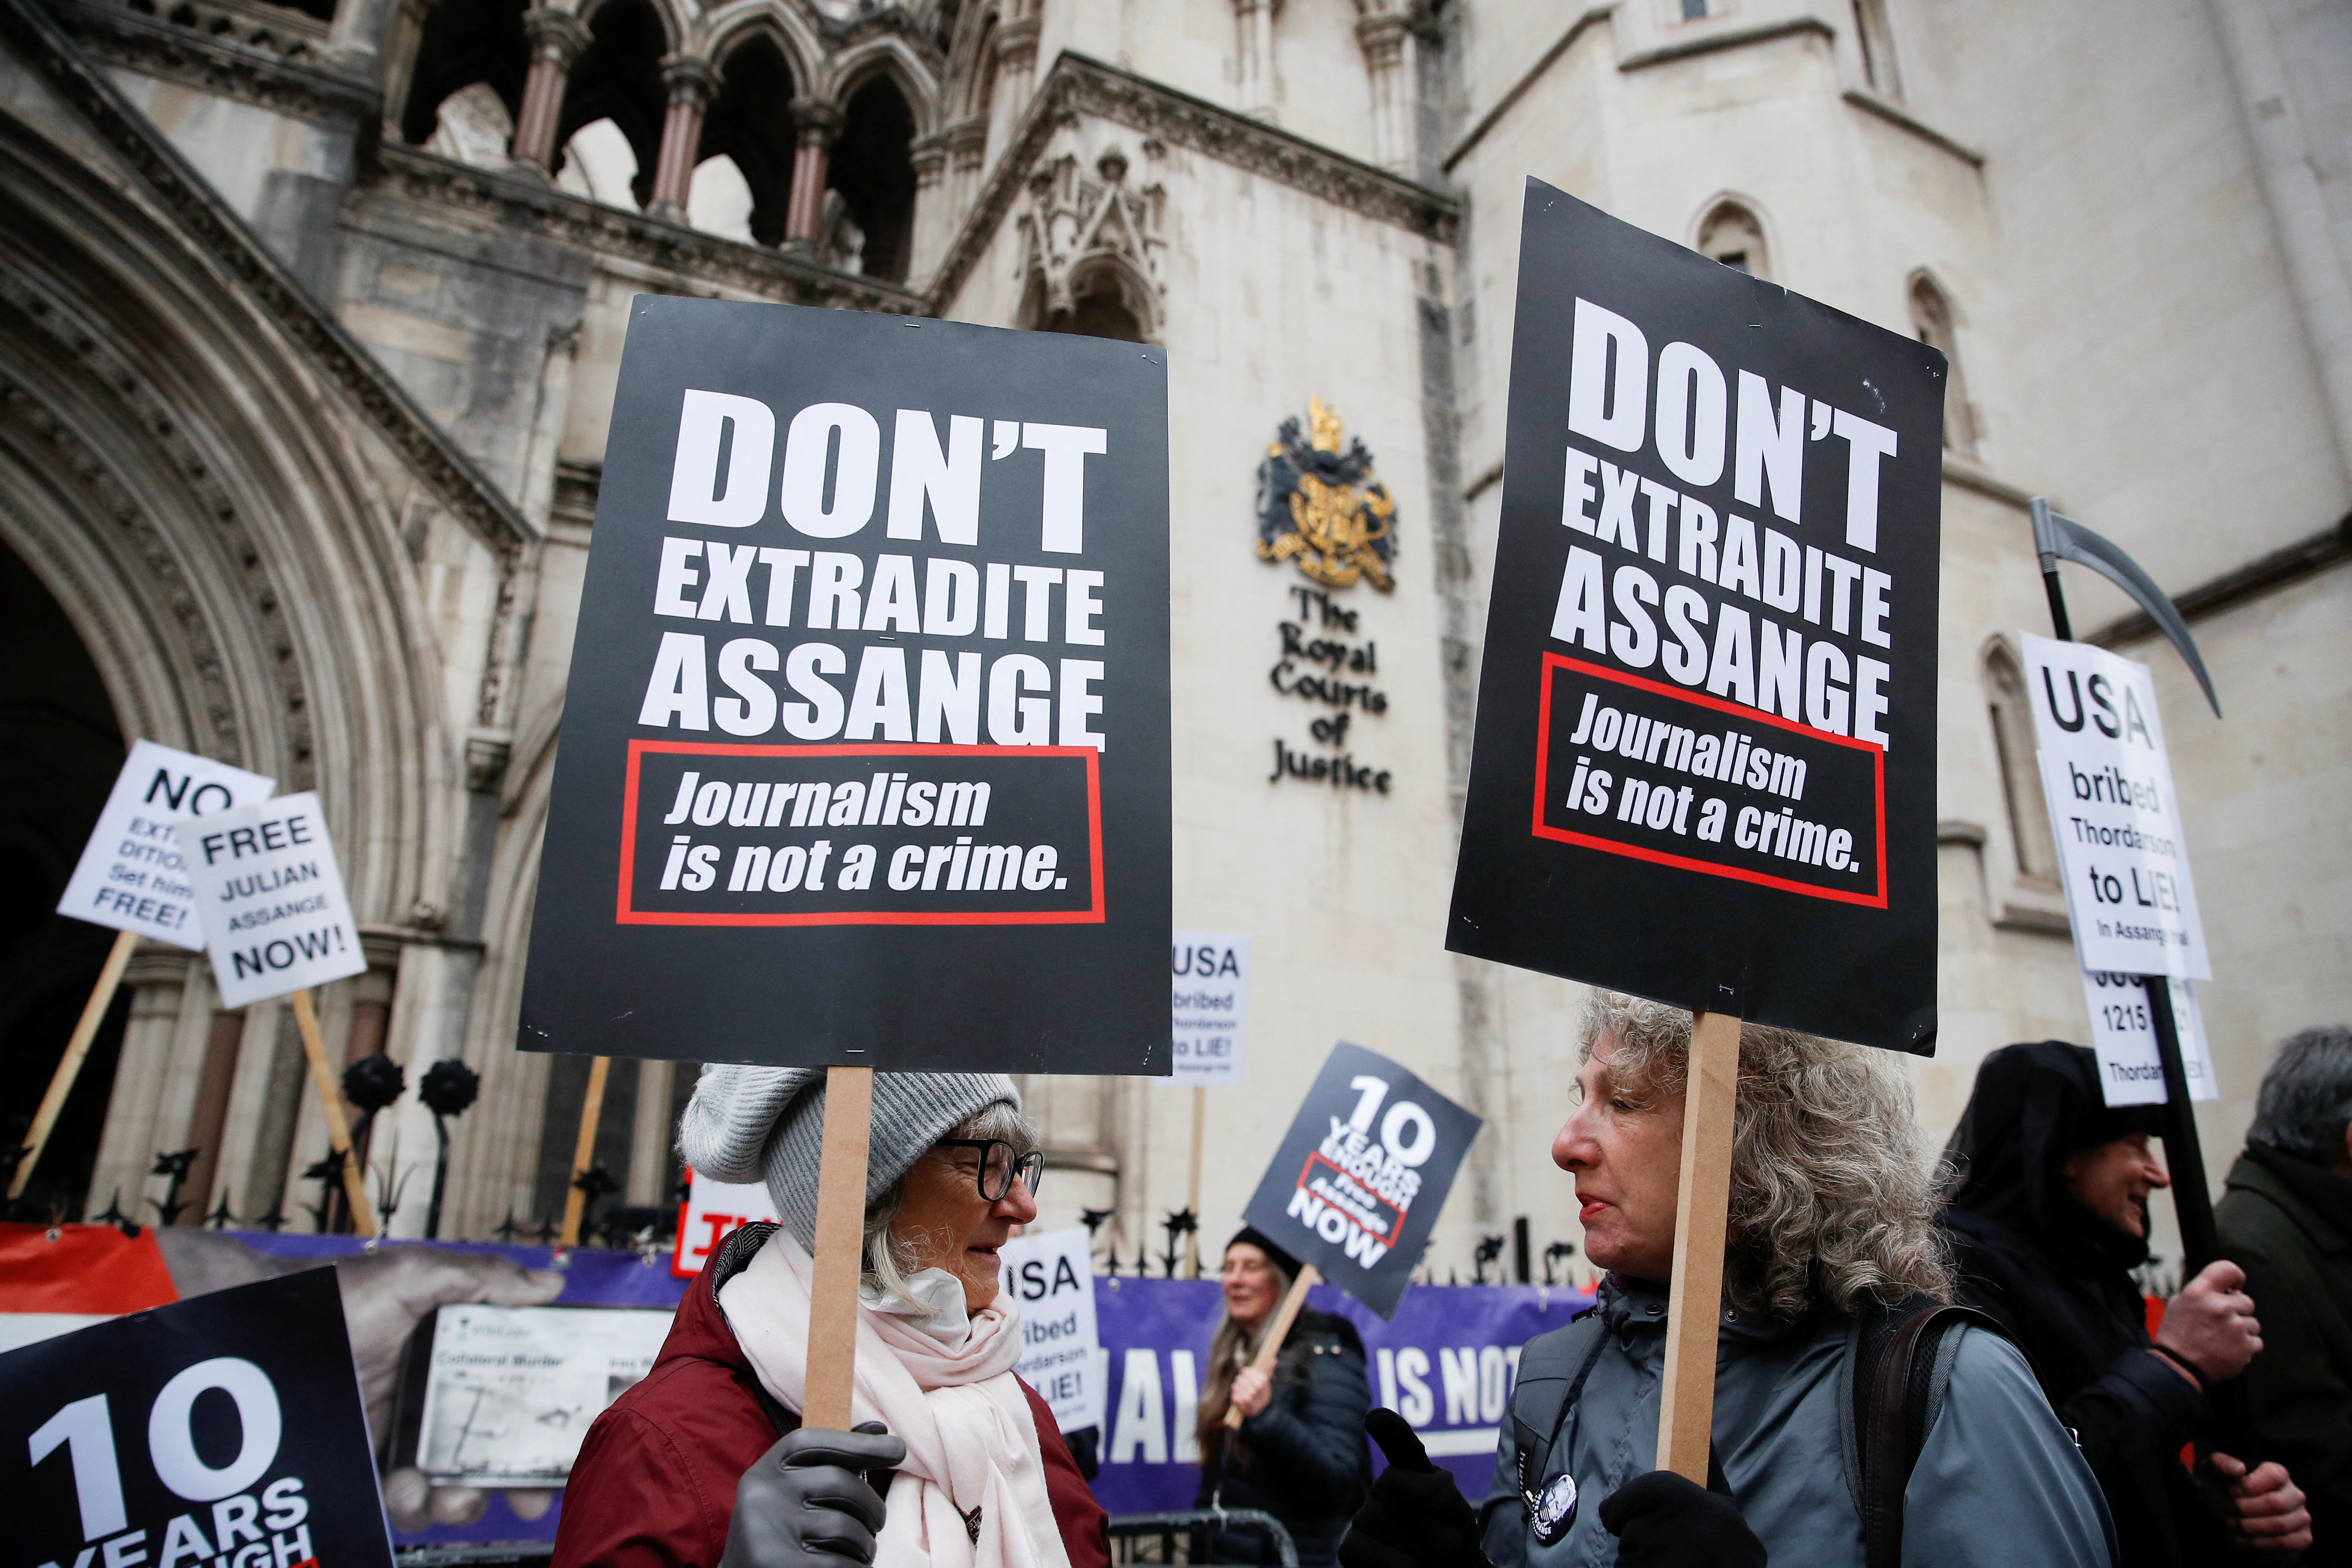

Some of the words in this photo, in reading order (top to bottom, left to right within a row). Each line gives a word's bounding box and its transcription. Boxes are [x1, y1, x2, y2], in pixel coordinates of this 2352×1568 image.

[1568, 297, 1897, 553] DON'T
[667, 389, 1107, 554] DON'T
[1562, 447, 1891, 649] EXTRADITE
[654, 537, 1105, 646] EXTRADITE
[1290, 585, 1358, 631] The
[1279, 621, 1376, 673] Royal
[1550, 545, 1889, 751] ASSANGE
[638, 632, 1105, 752] ASSANGE
[1271, 661, 1387, 714] Courts
[2042, 665, 2153, 750] USA
[1311, 713, 1349, 746] of
[1570, 693, 1806, 800] Journalism
[145, 768, 232, 815] NO
[1270, 738, 1391, 794] Justice
[2069, 762, 2159, 812] bribed
[664, 772, 990, 827] Journalism
[1566, 756, 1612, 815] is
[1617, 778, 1694, 835] not
[1697, 799, 1727, 842] a
[1735, 805, 1859, 873] crime.
[202, 816, 312, 864] FREE
[660, 836, 720, 891] is
[728, 841, 832, 892] not
[838, 845, 876, 890] a
[888, 836, 1067, 891] crime.
[109, 863, 145, 885] Set
[220, 862, 318, 901] JULIAN
[2090, 866, 2122, 903] to
[93, 886, 188, 929] FREE!
[229, 892, 329, 931] ASSANGE
[232, 925, 346, 980] NOW!
[1173, 946, 1239, 978] USA
[1173, 992, 1234, 1011] bribed
[1173, 1017, 1237, 1029] hordarson
[1350, 1075, 1436, 1167] 10
[1318, 1136, 1413, 1212] ENOUGH
[1330, 1115, 1421, 1196] YEARS
[1286, 1188, 1387, 1269] NOW
[1376, 1346, 1434, 1427] IS
[28, 1357, 282, 1541] 10
